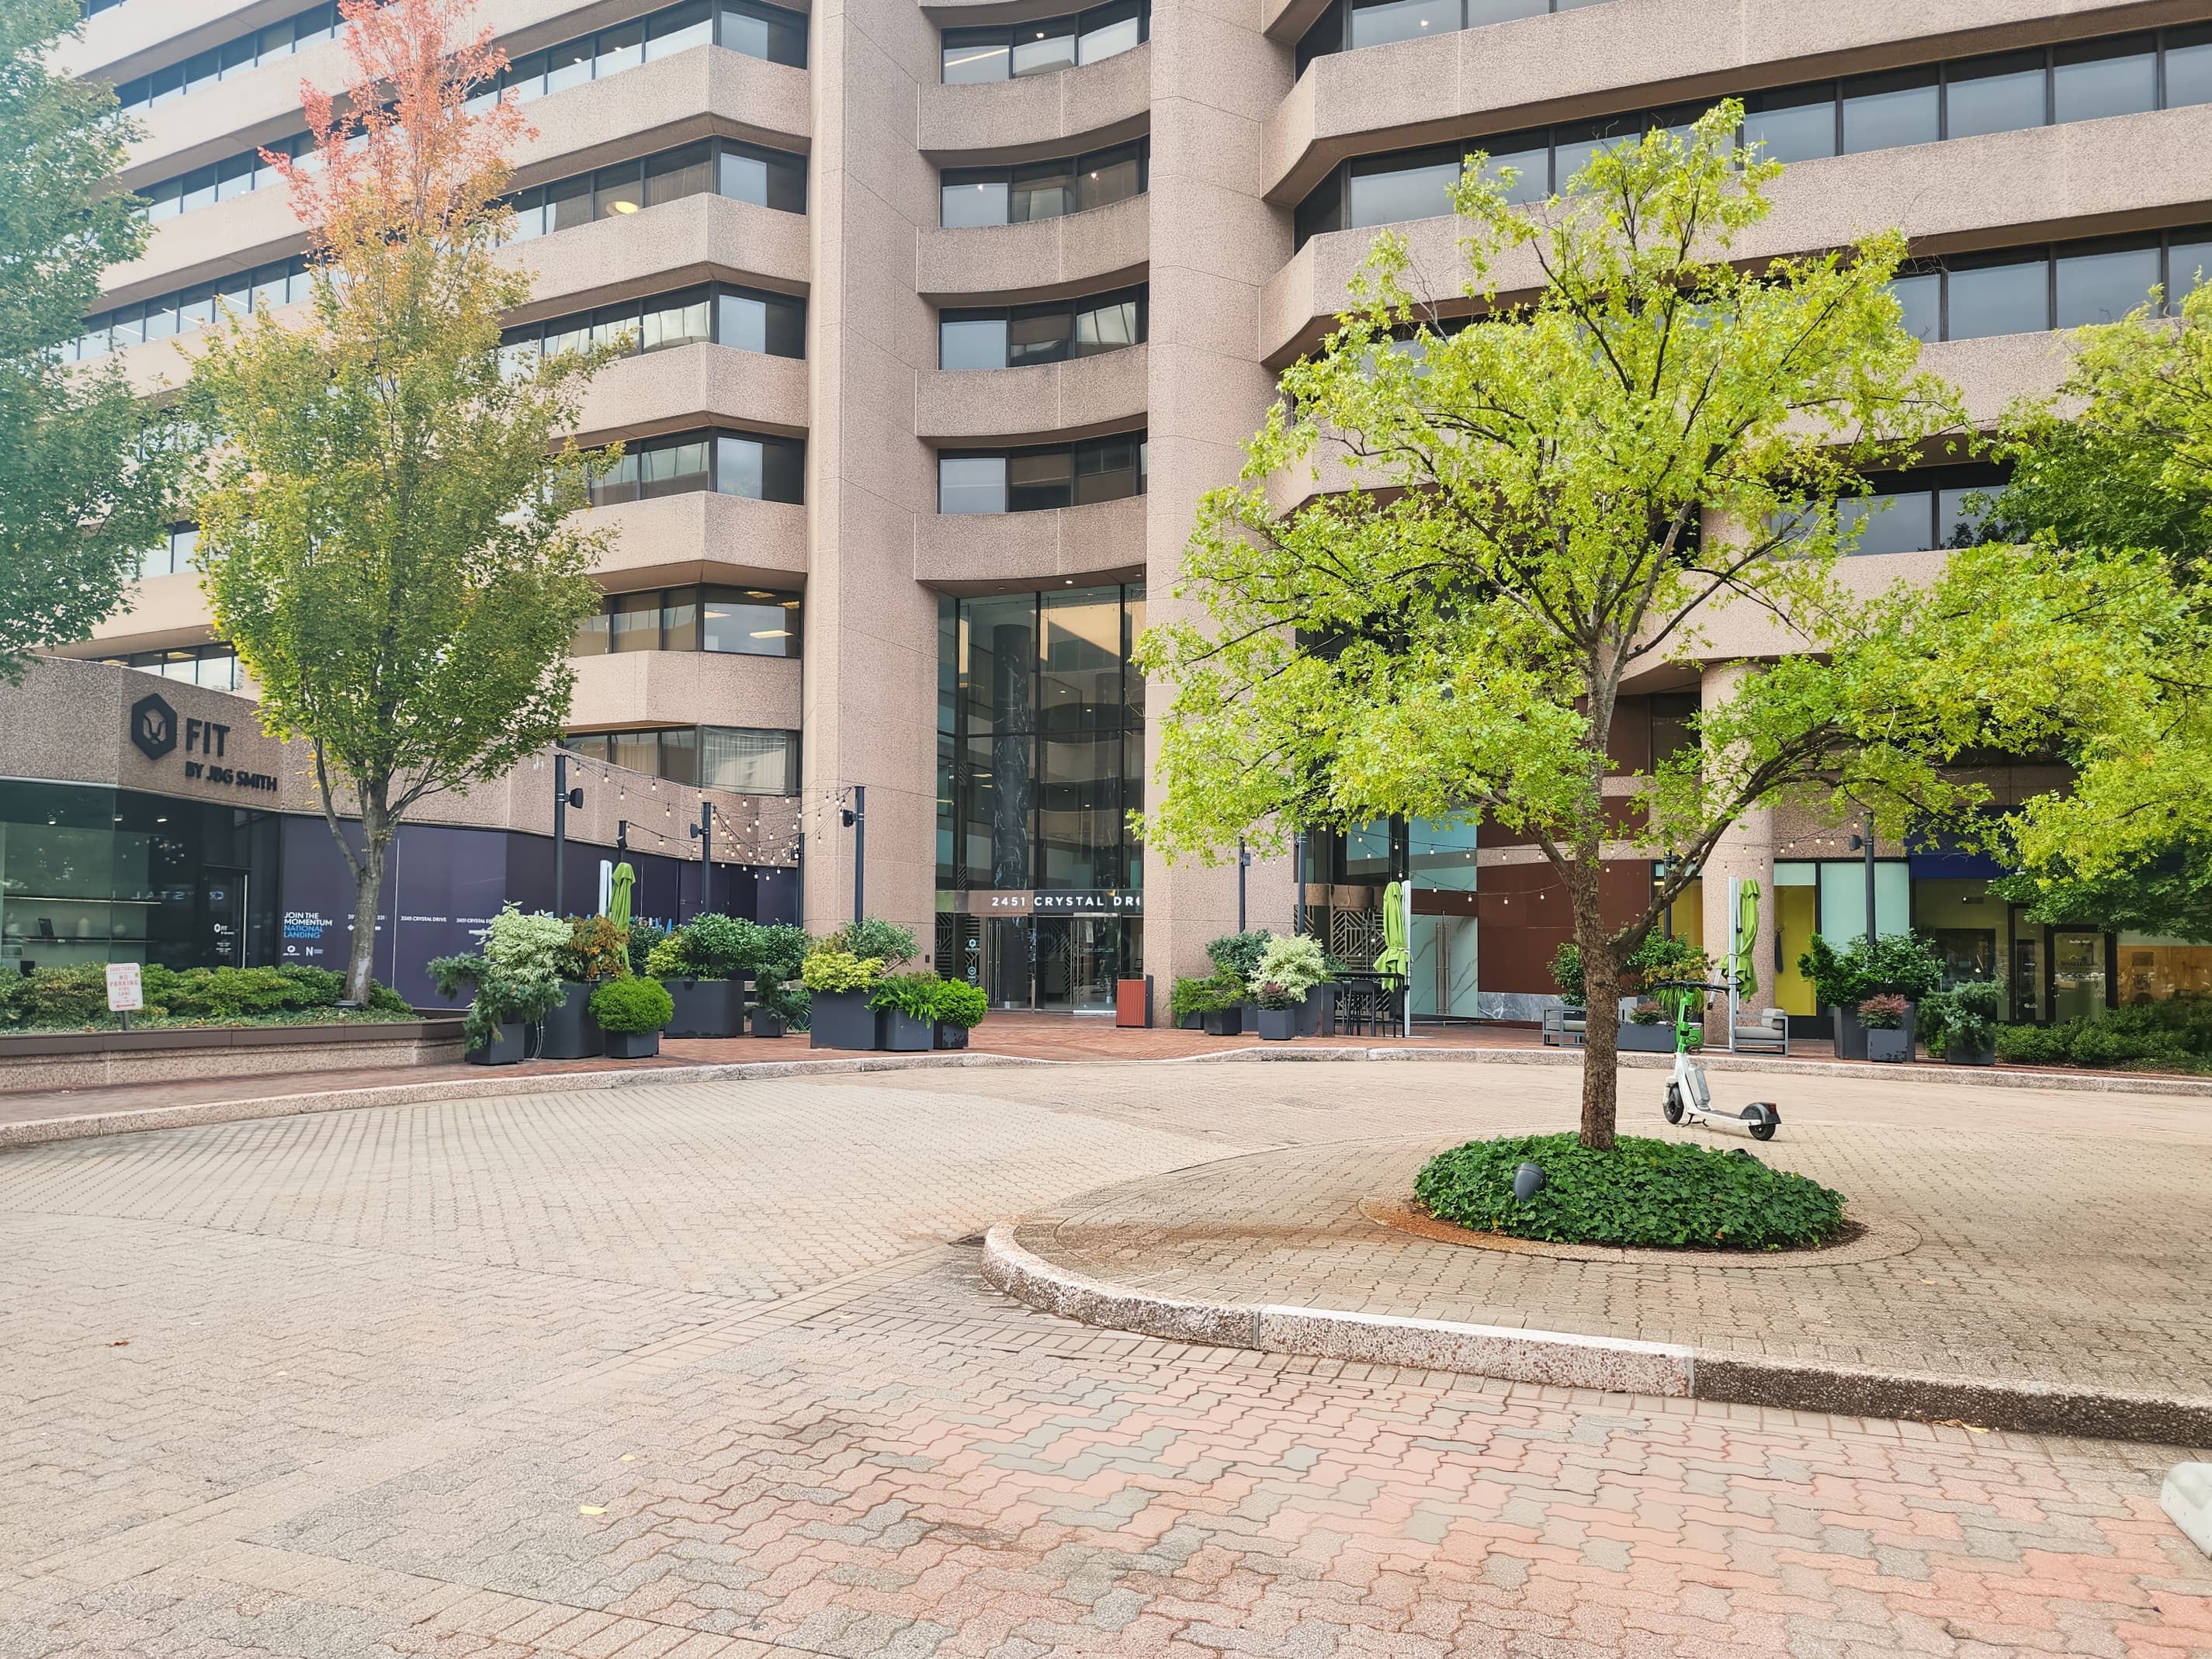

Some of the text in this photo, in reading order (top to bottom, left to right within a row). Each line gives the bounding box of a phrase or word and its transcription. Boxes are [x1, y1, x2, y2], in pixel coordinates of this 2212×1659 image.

[185, 717, 231, 757] FIT
[185, 760, 278, 791] BY JBG SMITH
[992, 896, 1025, 906] 2451
[1034, 896, 1104, 906] CRYSTAL
